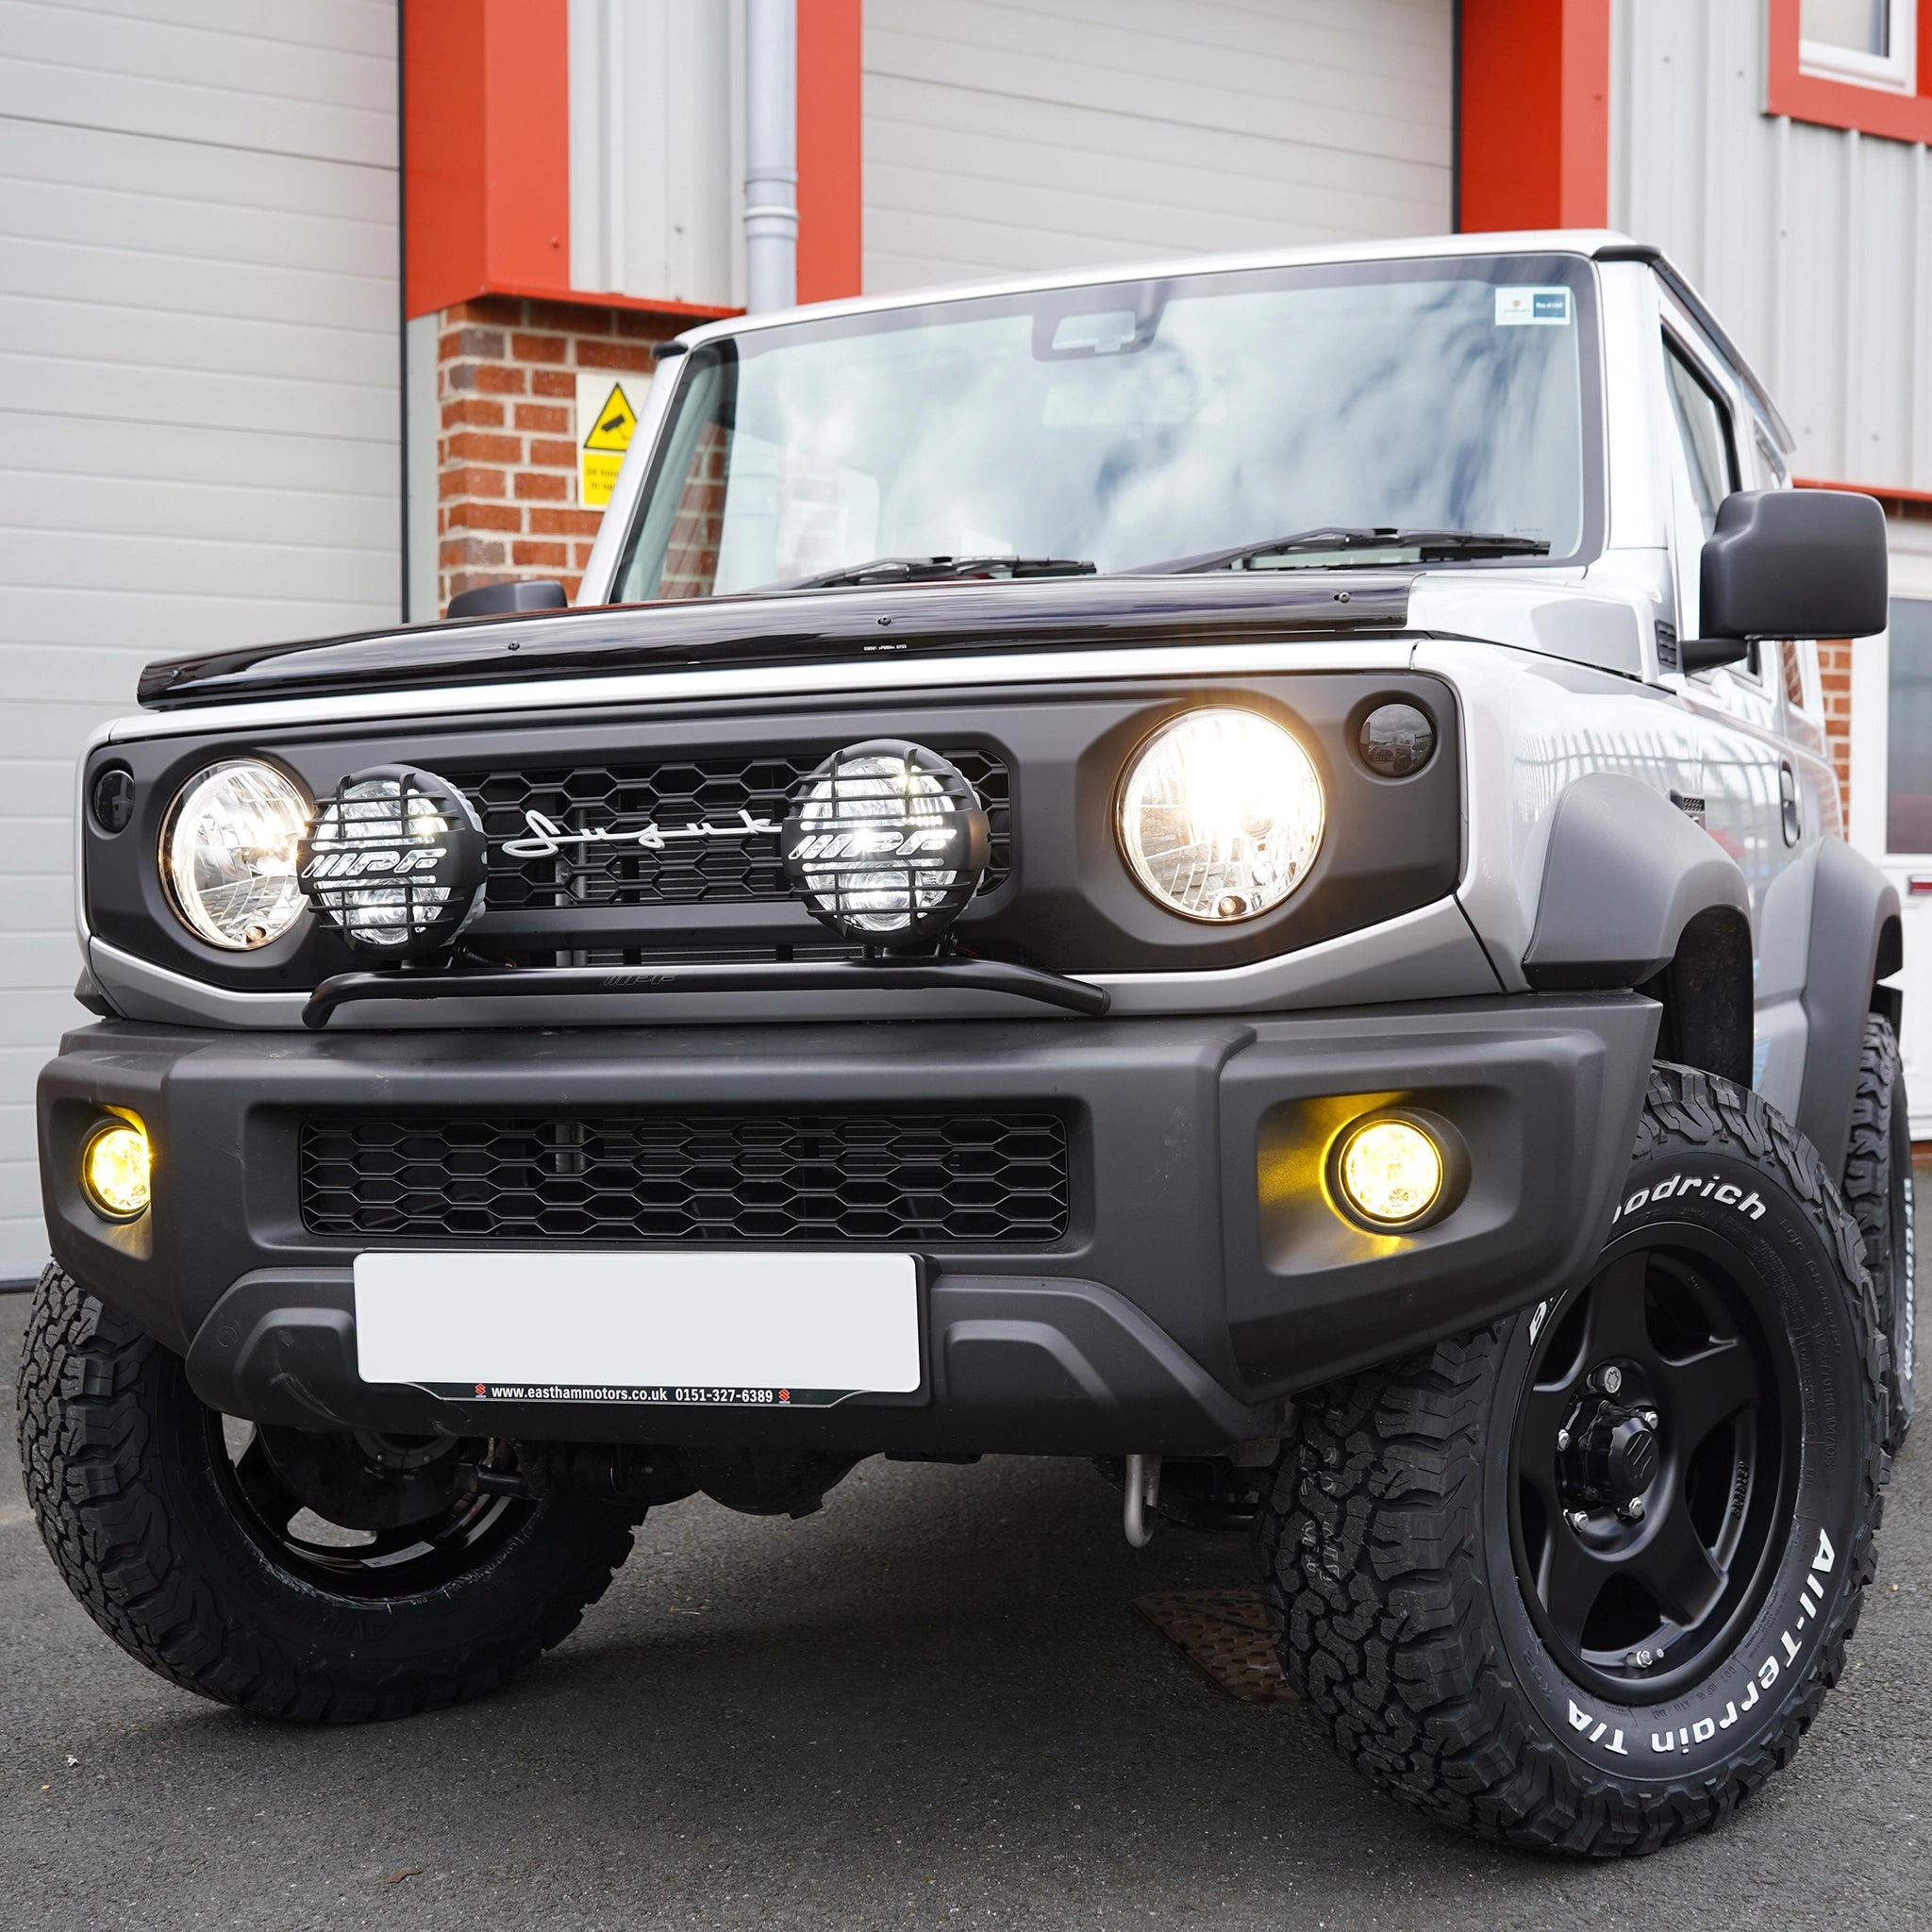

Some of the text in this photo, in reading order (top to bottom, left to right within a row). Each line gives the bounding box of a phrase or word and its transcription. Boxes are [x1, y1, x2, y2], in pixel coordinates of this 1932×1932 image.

[502, 808, 782, 858] Suzuk
[491, 1384, 774, 1404] www.easthammotors.co.uk 0151-327-6389
[1651, 1528, 1836, 1754] All-Terrain
